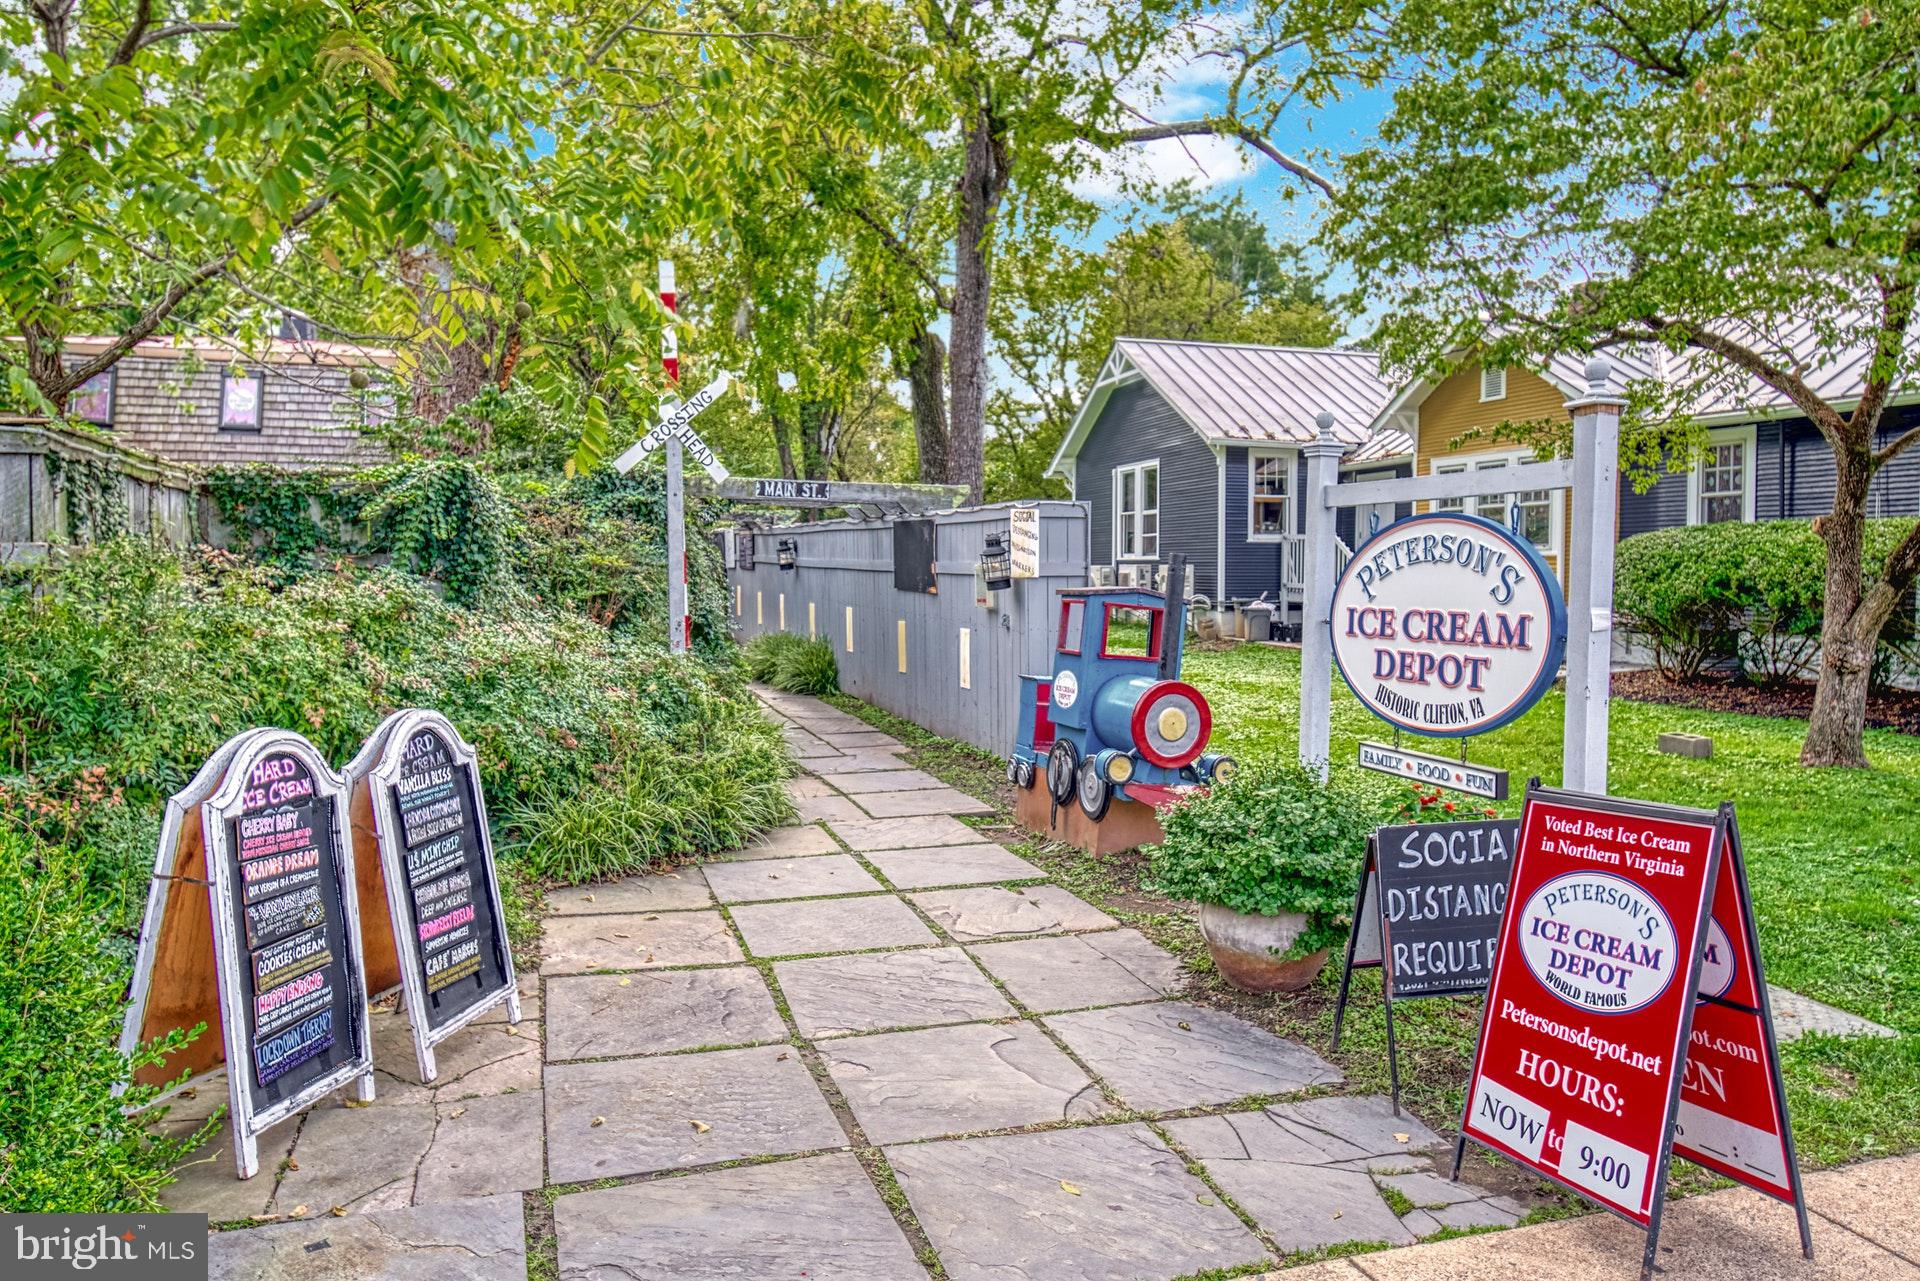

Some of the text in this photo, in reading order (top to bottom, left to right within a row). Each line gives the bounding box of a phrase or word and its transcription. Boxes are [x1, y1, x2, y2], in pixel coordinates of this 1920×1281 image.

[640, 390, 713, 453] CROSSING
[678, 429, 713, 467] HEAD
[764, 481, 822, 498] MAIN ST.
[1355, 534, 1525, 605] PETERSON'S
[1345, 606, 1534, 651] ICE CREAM
[1373, 647, 1492, 692] DEPOT
[1374, 683, 1486, 724] HISTORIC CLIFTON, VA
[252, 759, 295, 786] HARD
[269, 778, 312, 804] CREAM
[397, 774, 431, 794] VANILLA
[431, 766, 452, 785] BLISS
[1363, 750, 1494, 792] FAMILY FOOD FUN
[241, 815, 275, 838] CHERRY
[276, 811, 299, 832] BABY
[1544, 815, 1691, 854] Voted Best Ice Cream
[285, 849, 319, 873] DREAM
[419, 841, 442, 865] MINT
[441, 835, 460, 855] CHIP
[1398, 827, 1519, 869] SOCIA
[1540, 837, 1685, 877] in Northern Virginia
[1387, 882, 1509, 923] DISTANC
[1543, 883, 1660, 940] PETERSON'S
[258, 952, 293, 977] COOKIES
[296, 938, 327, 959] CREAM
[1530, 916, 1570, 945] ICE
[1574, 928, 1664, 971] CREAM
[1545, 970, 1627, 1007] WORLD FAMOUS
[1547, 948, 1633, 990] DEPOT
[258, 985, 288, 1016] HAPPY
[287, 971, 323, 1001] ENDING
[256, 1031, 300, 1066] LOCKDOWN
[301, 1009, 332, 1041] THERAPY
[1500, 999, 1662, 1077] Petersonsdepot.net
[1515, 1048, 1626, 1117] HOURS:
[1479, 1092, 1631, 1189] NOW to 9:00
